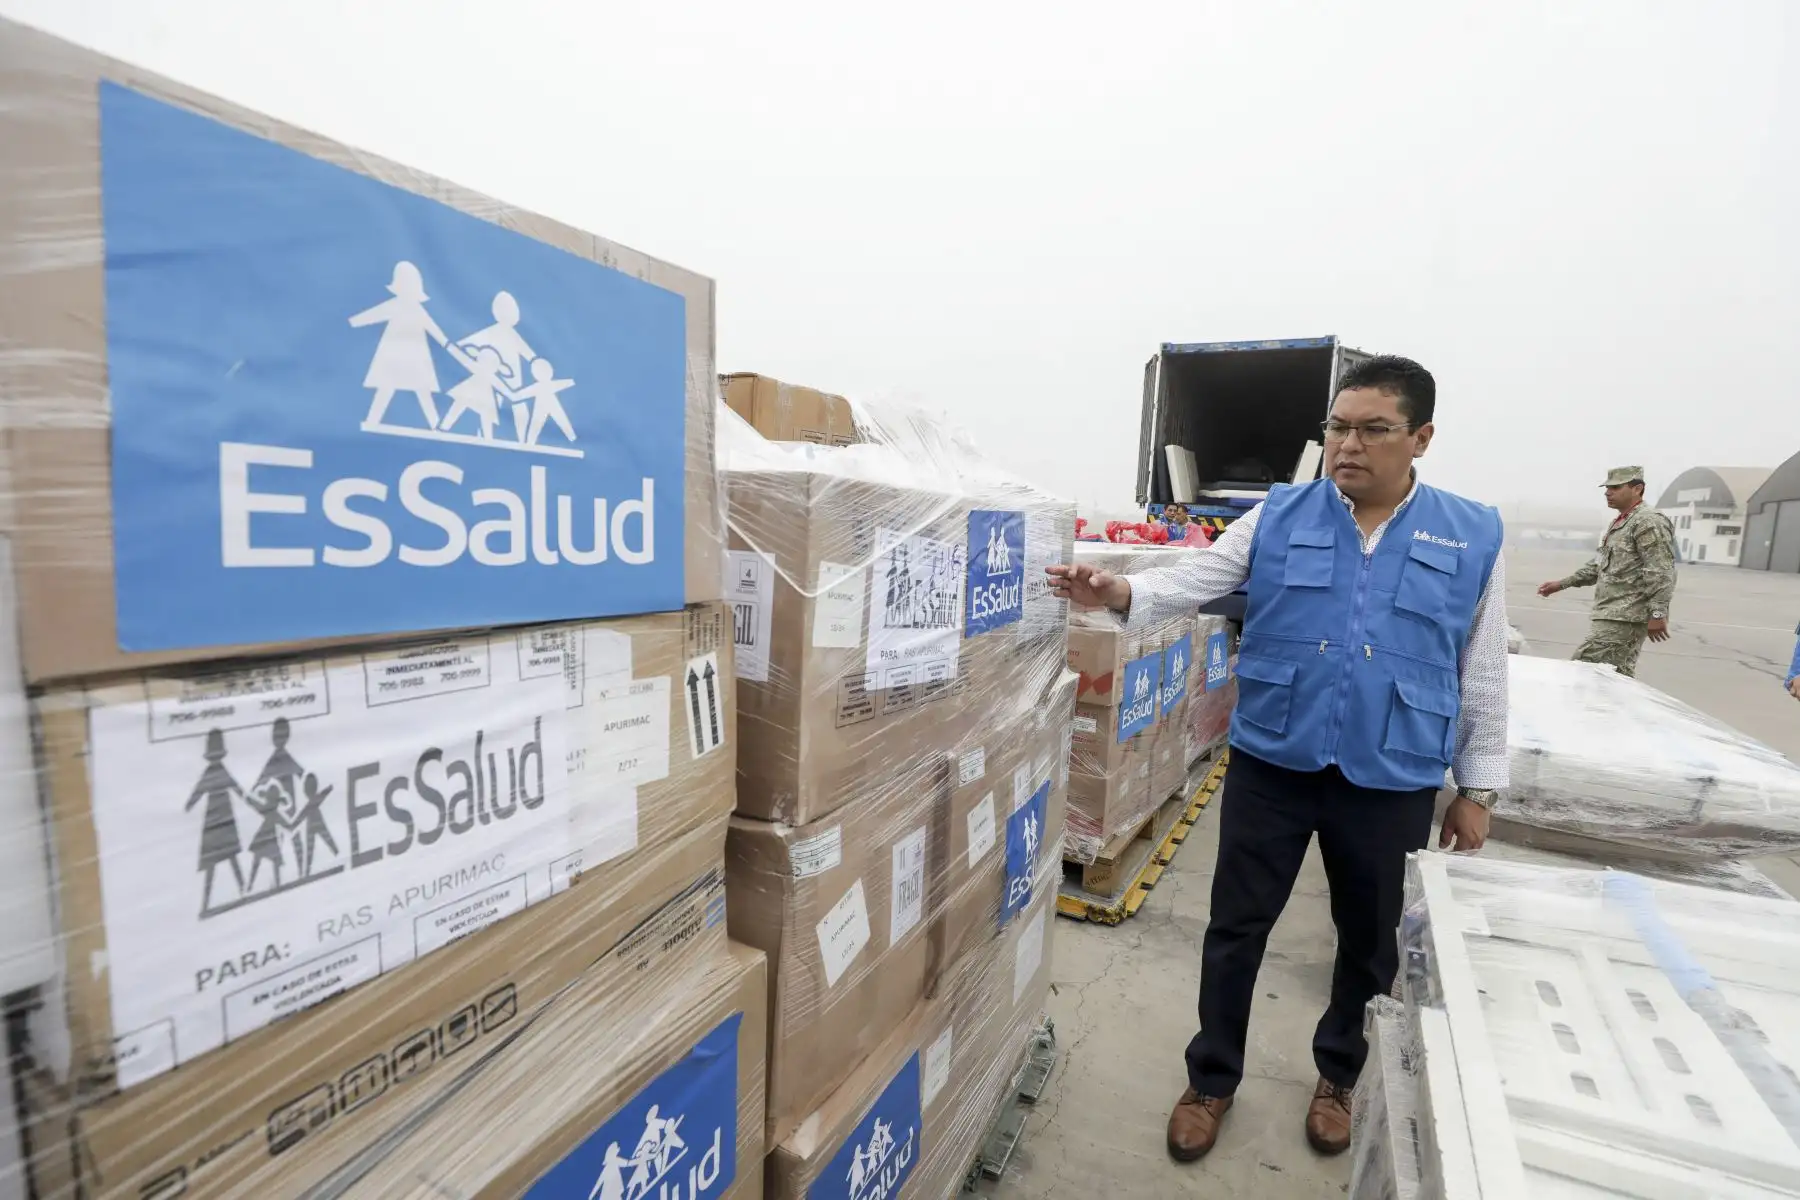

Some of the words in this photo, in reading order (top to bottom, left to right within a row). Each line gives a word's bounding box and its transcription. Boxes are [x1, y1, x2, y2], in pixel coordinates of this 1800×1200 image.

[220, 441, 654, 567] EsSalud
[1432, 536, 1467, 548] EsSalud
[972, 576, 1020, 620] EsSalud
[1164, 671, 1185, 705] EsSalud
[1208, 664, 1227, 683] EsSalud
[604, 715, 651, 734] APURIMAC
[1122, 695, 1153, 730] EsSalud
[347, 716, 545, 869] EsSalud
[316, 905, 374, 943] RAS
[388, 853, 507, 916] APURIMAC
[195, 942, 291, 992] PARA:
